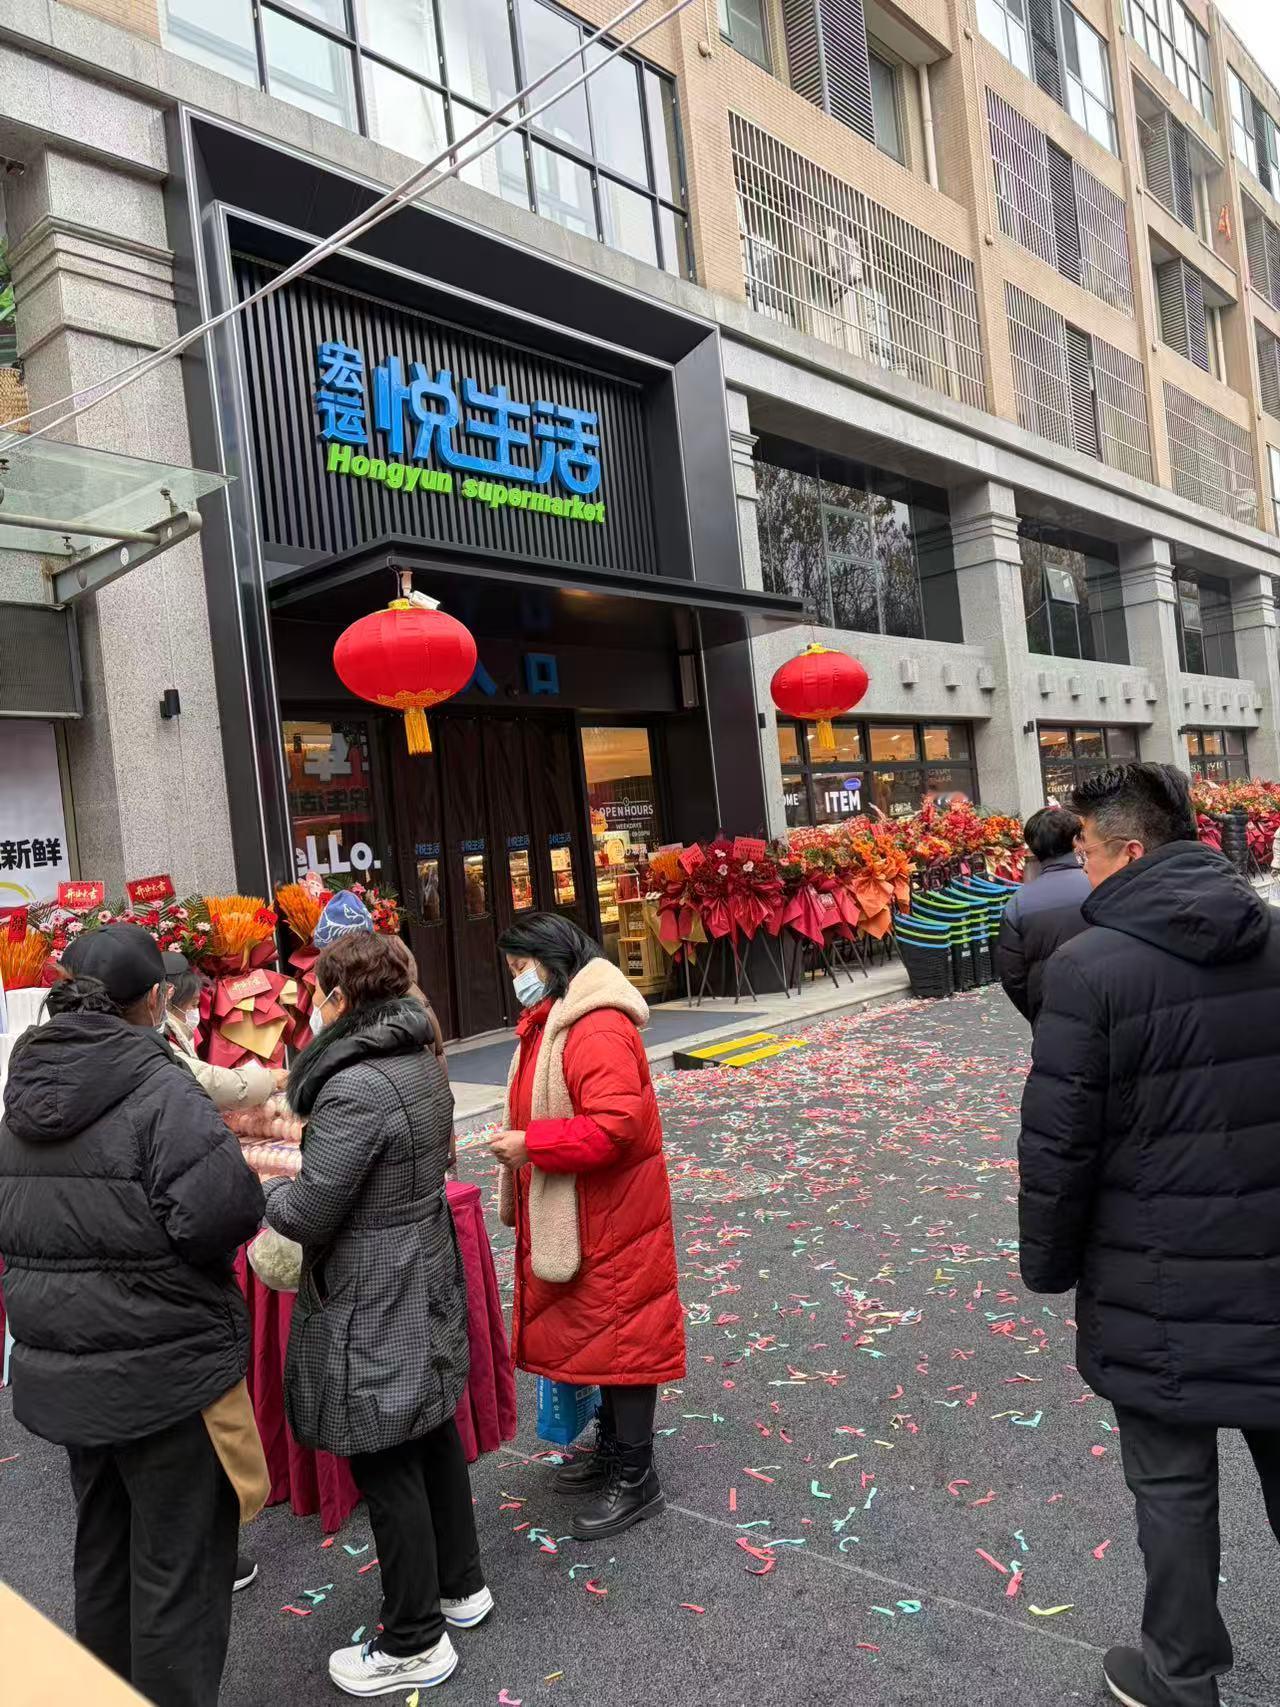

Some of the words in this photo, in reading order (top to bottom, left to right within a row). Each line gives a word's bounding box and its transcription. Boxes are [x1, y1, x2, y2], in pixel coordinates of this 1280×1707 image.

[316, 341, 368, 445] 宏运
[373, 354, 600, 494] 悦生活
[326, 442, 453, 493] Hongyun
[461, 477, 606, 523] supermarket
[824, 790, 861, 814] ITEM
[0, 838, 63, 871] 新鲜
